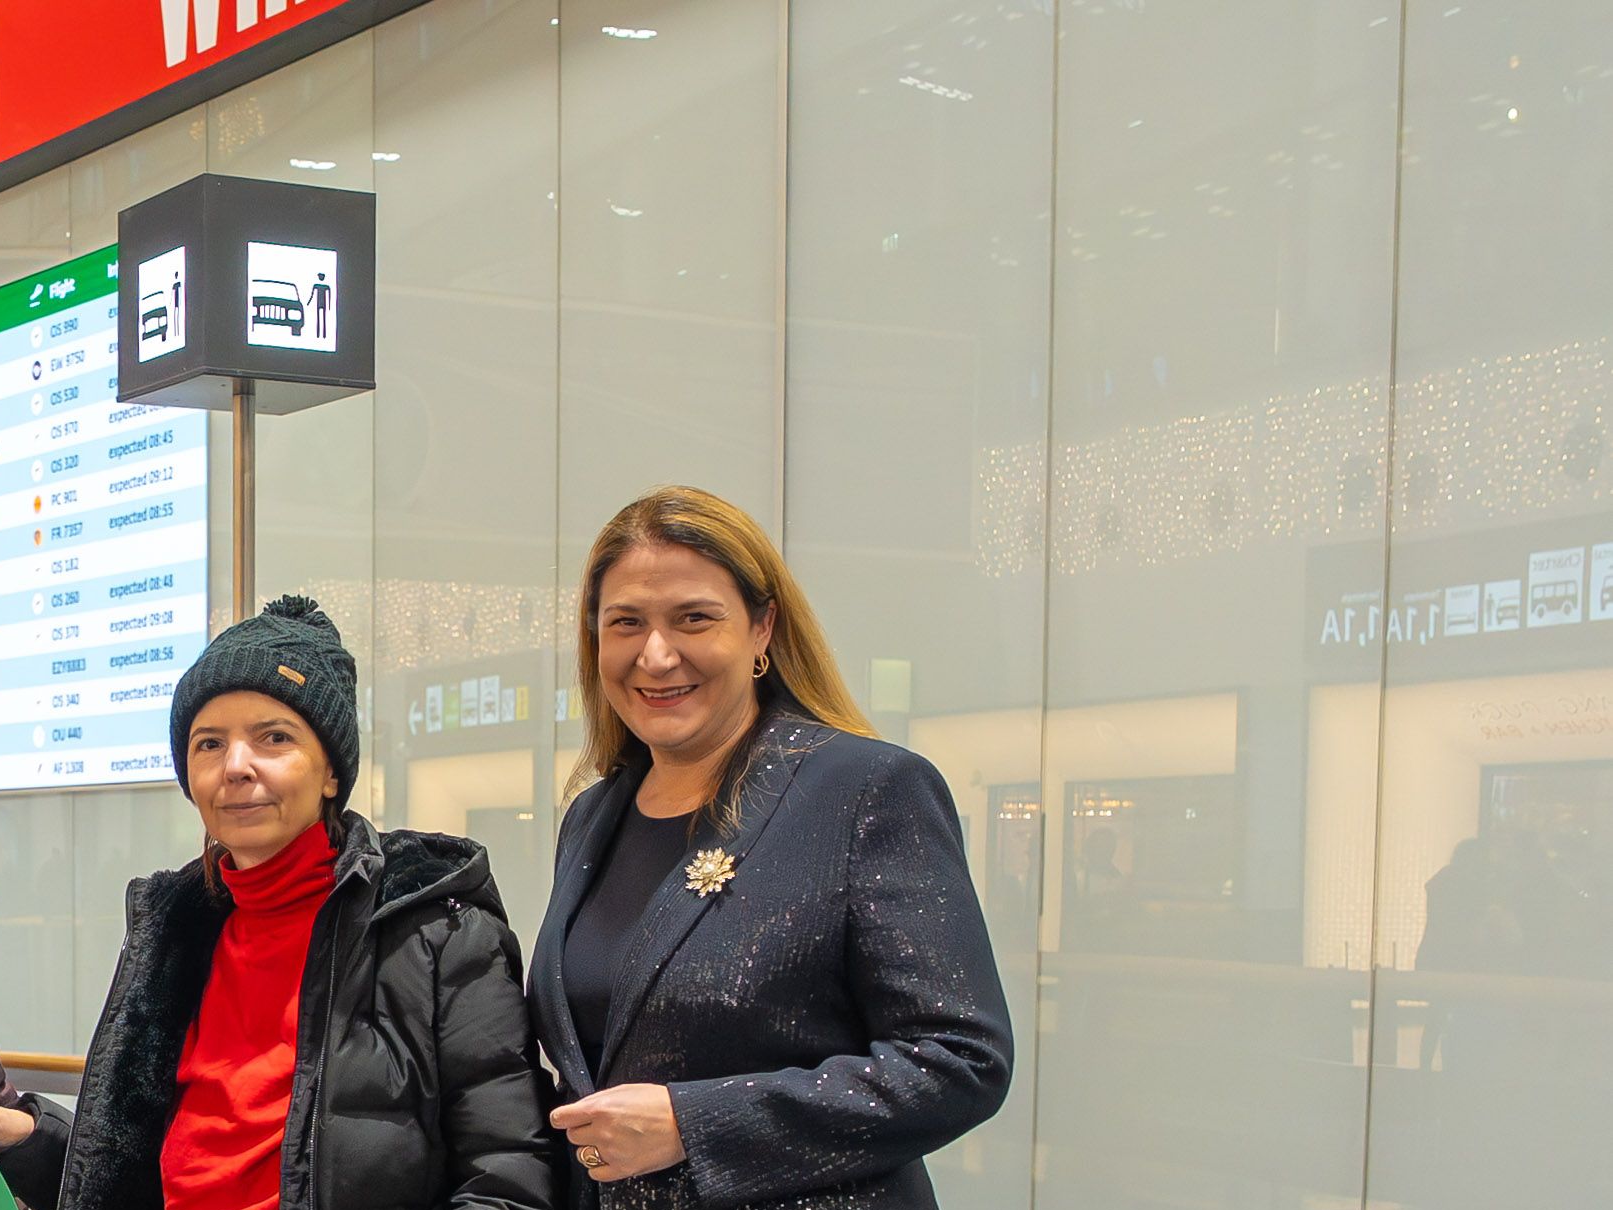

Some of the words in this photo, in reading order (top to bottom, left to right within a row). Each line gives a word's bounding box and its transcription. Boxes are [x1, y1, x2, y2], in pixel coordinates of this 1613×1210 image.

[49, 278, 76, 299] Flight
[108, 436, 148, 459] expected
[148, 429, 173, 448] 08:45
[109, 473, 147, 493] expected
[148, 466, 173, 484] 09:12
[108, 507, 148, 529] expected
[148, 501, 174, 520] 08:55
[108, 578, 148, 598] expected
[109, 616, 147, 632] expected
[109, 649, 148, 669] expected
[110, 686, 148, 702] expected
[110, 756, 148, 772] expected
